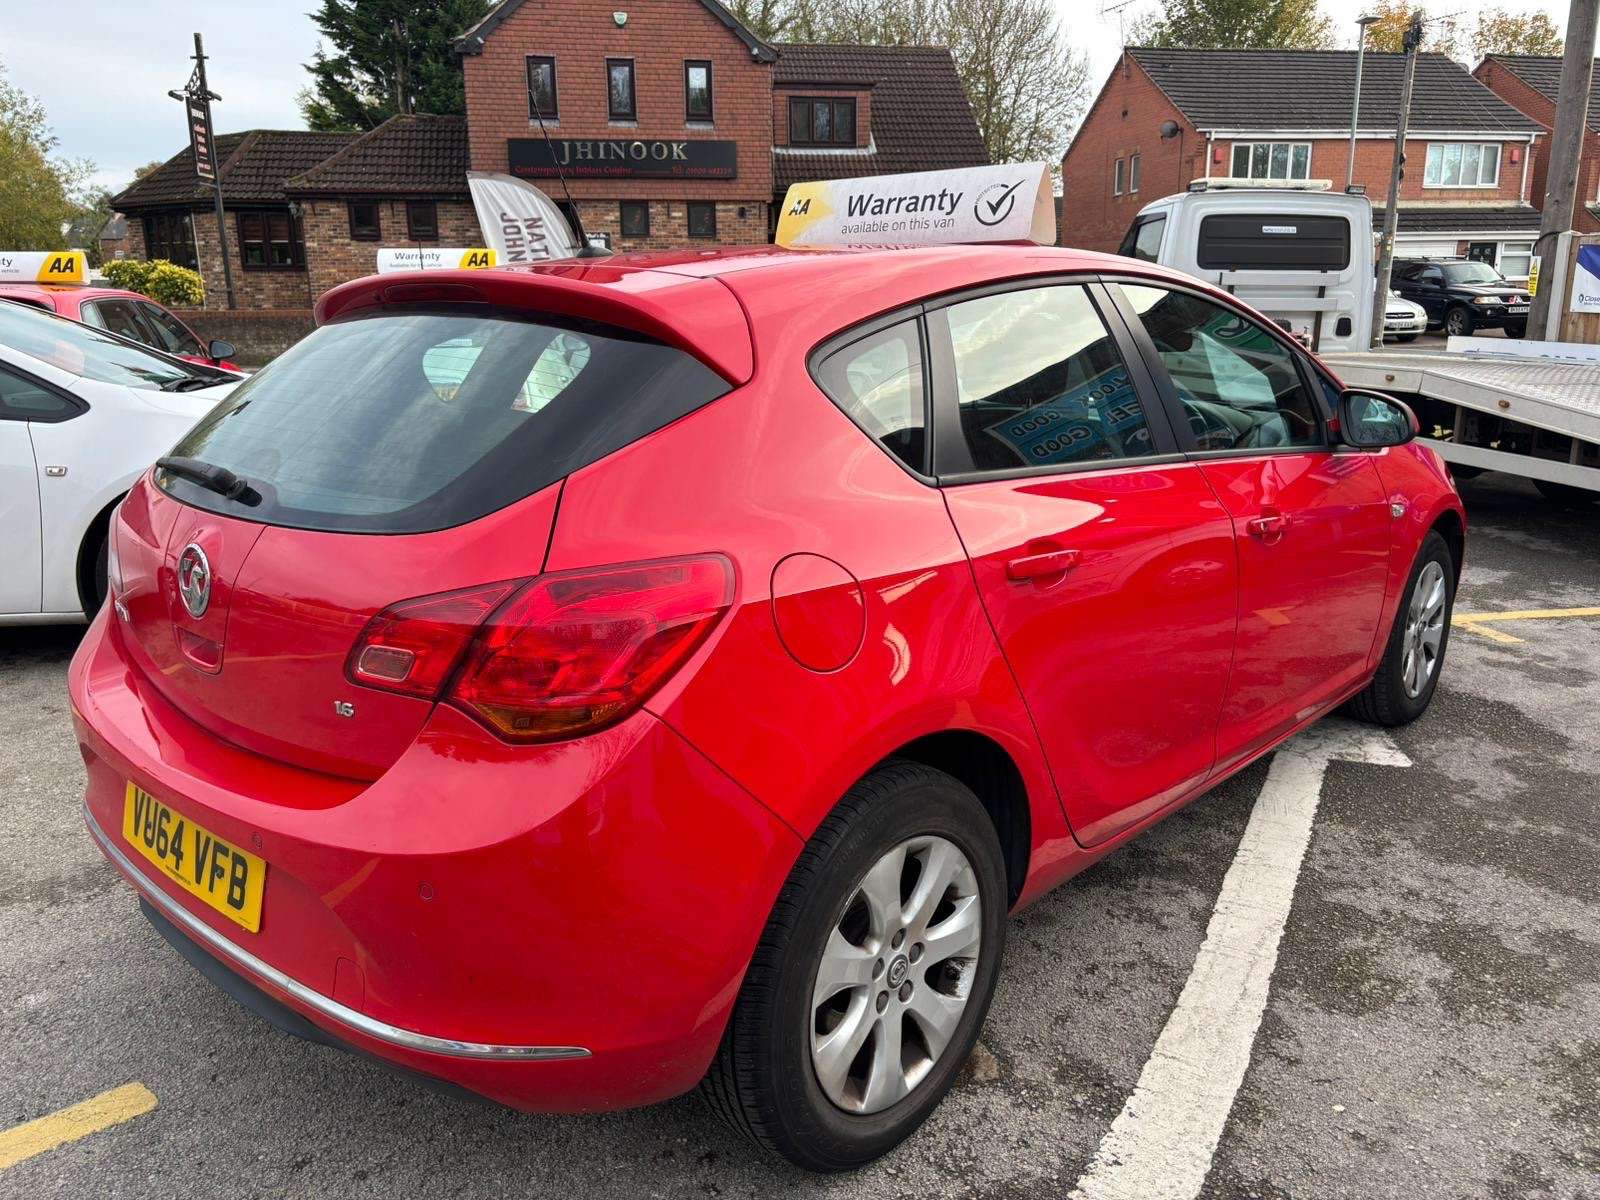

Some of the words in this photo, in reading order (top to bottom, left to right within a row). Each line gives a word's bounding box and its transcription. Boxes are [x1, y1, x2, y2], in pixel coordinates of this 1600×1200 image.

[560, 141, 688, 165] JHINOOK
[789, 198, 812, 216] AA
[847, 187, 963, 218] Warranty
[500, 212, 527, 262] JOHN
[841, 218, 888, 234] available
[892, 220, 906, 231] on
[909, 217, 930, 230] this
[933, 218, 955, 229] van
[49, 257, 75, 273] AA
[395, 252, 441, 261] Warranty
[467, 252, 489, 267] AA
[134, 786, 185, 872] VU64
[195, 829, 249, 911] VFB
